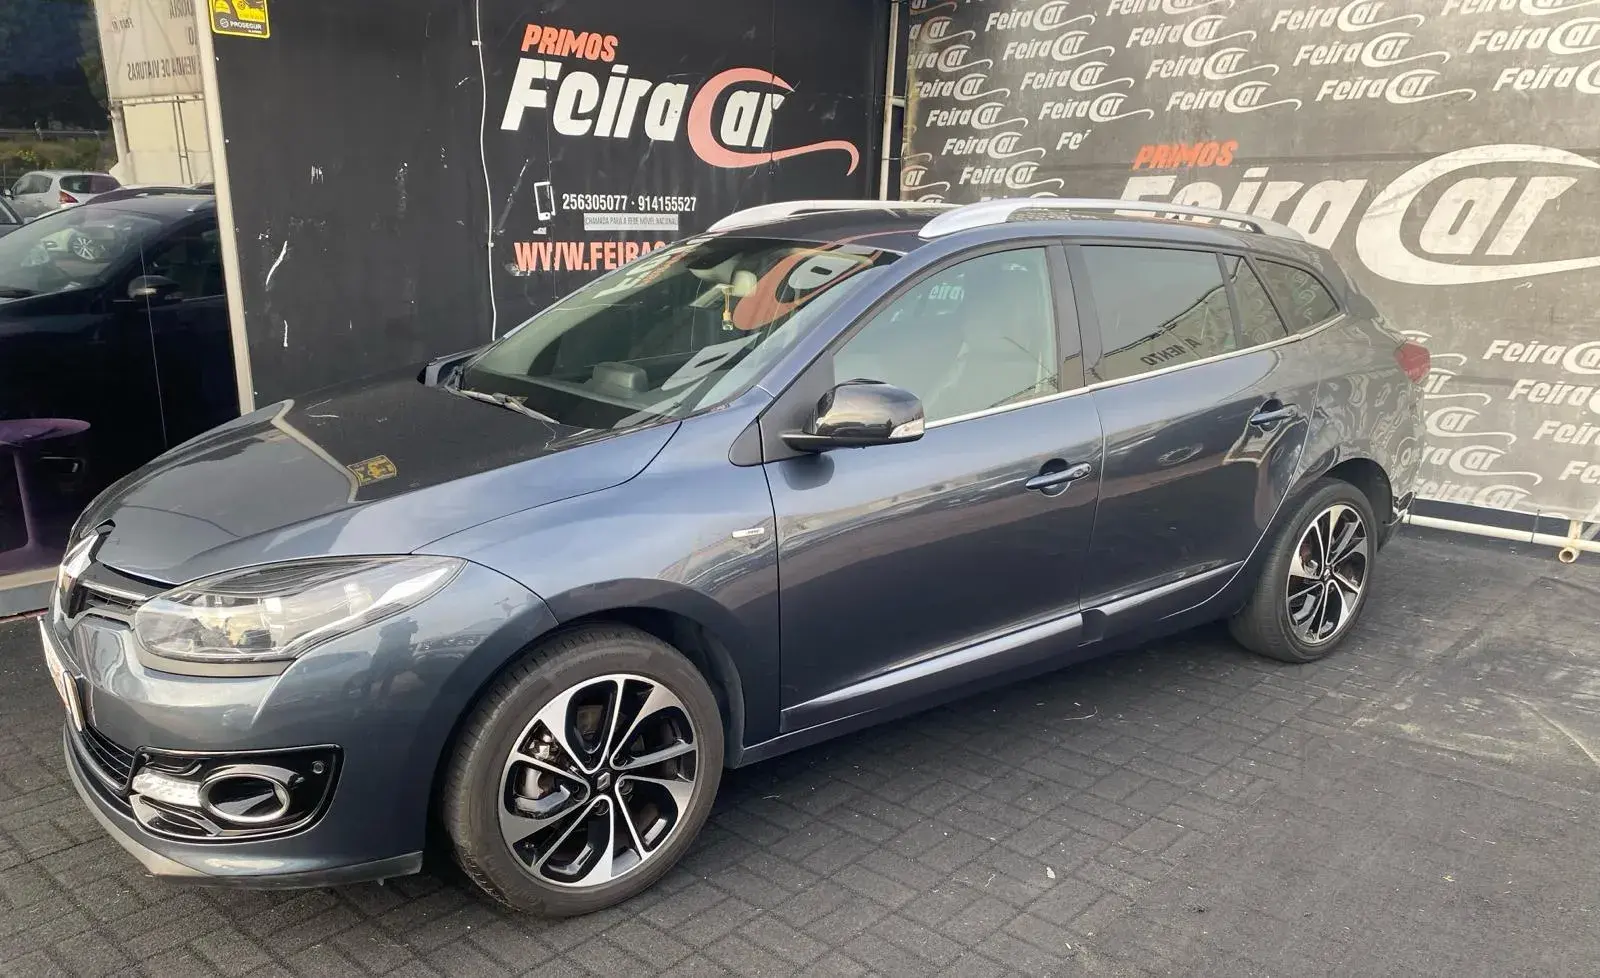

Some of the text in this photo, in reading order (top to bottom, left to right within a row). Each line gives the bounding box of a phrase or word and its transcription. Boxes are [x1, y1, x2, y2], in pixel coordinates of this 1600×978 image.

[230, 20, 262, 30] PROSEGUR
[984, 1, 1096, 31] FeiraCar
[1126, 15, 1257, 48] FeiraCar
[521, 24, 618, 62] PRIMOS
[1003, 30, 1115, 61] FeiraCar
[1293, 32, 1451, 68] FeiraCar
[1020, 61, 1135, 92] FeiraCar
[1145, 48, 1280, 80] FeiraCar
[1165, 81, 1302, 113] FeiraCar
[1315, 69, 1477, 104] FeiraCar
[926, 102, 1029, 130] FeiraCar
[1038, 93, 1154, 122] FeiraCar
[941, 131, 1046, 159] FeiraCar
[1132, 140, 1239, 171] PRIMOS
[959, 161, 1065, 190] FeiraCar
[562, 193, 697, 212] 256305077 914155527
[514, 241, 666, 271] WWW.FEIR
[1508, 379, 1600, 414] Feira
[1533, 420, 1600, 445] Feir
